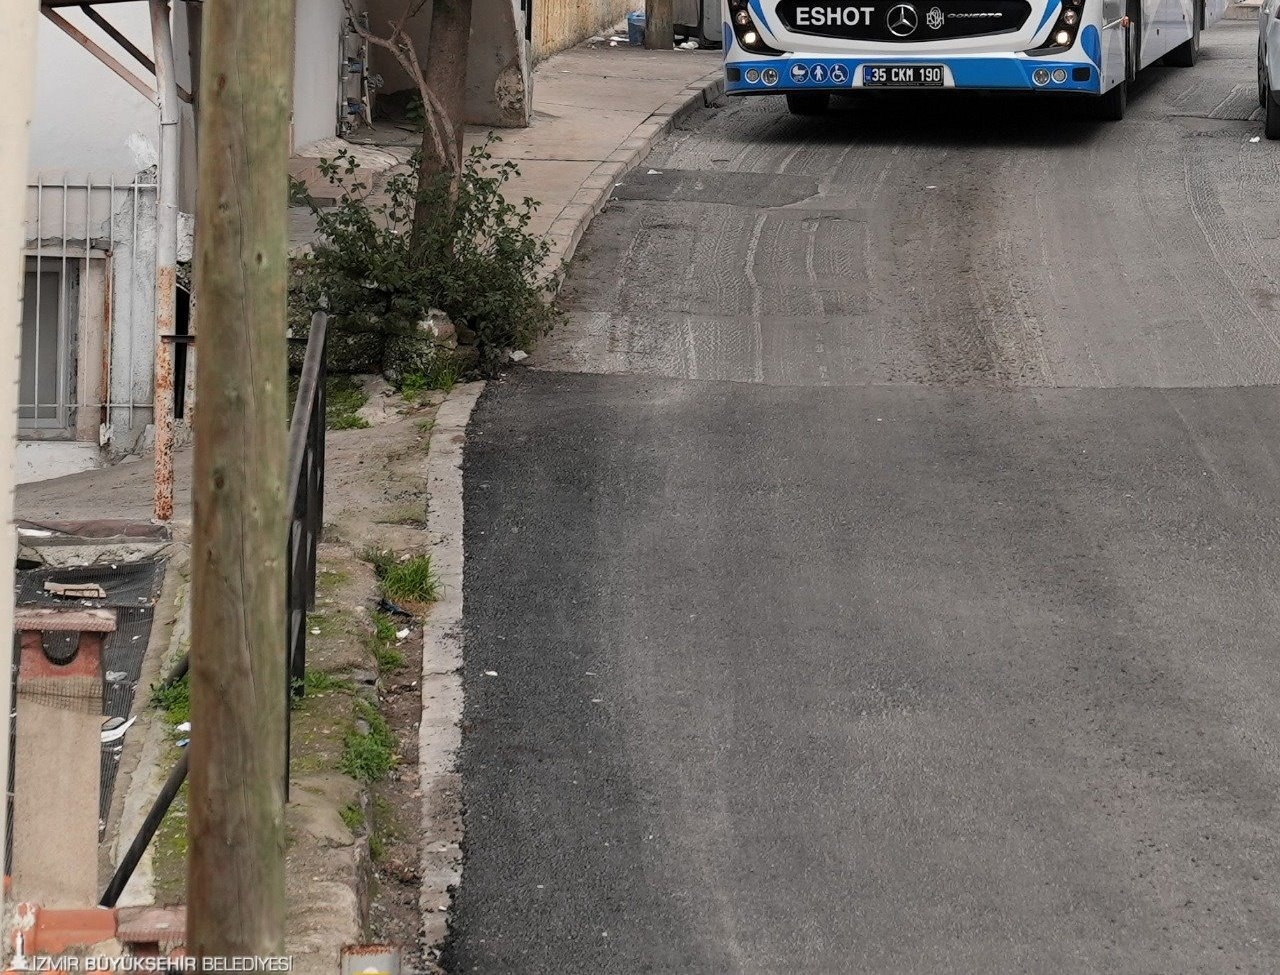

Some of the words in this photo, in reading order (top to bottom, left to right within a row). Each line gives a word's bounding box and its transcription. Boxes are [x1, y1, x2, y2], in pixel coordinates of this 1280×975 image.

[796, 7, 875, 26] ESHOT
[871, 68, 887, 82] 35
[891, 68, 914, 82] CKM
[919, 68, 941, 82] 190
